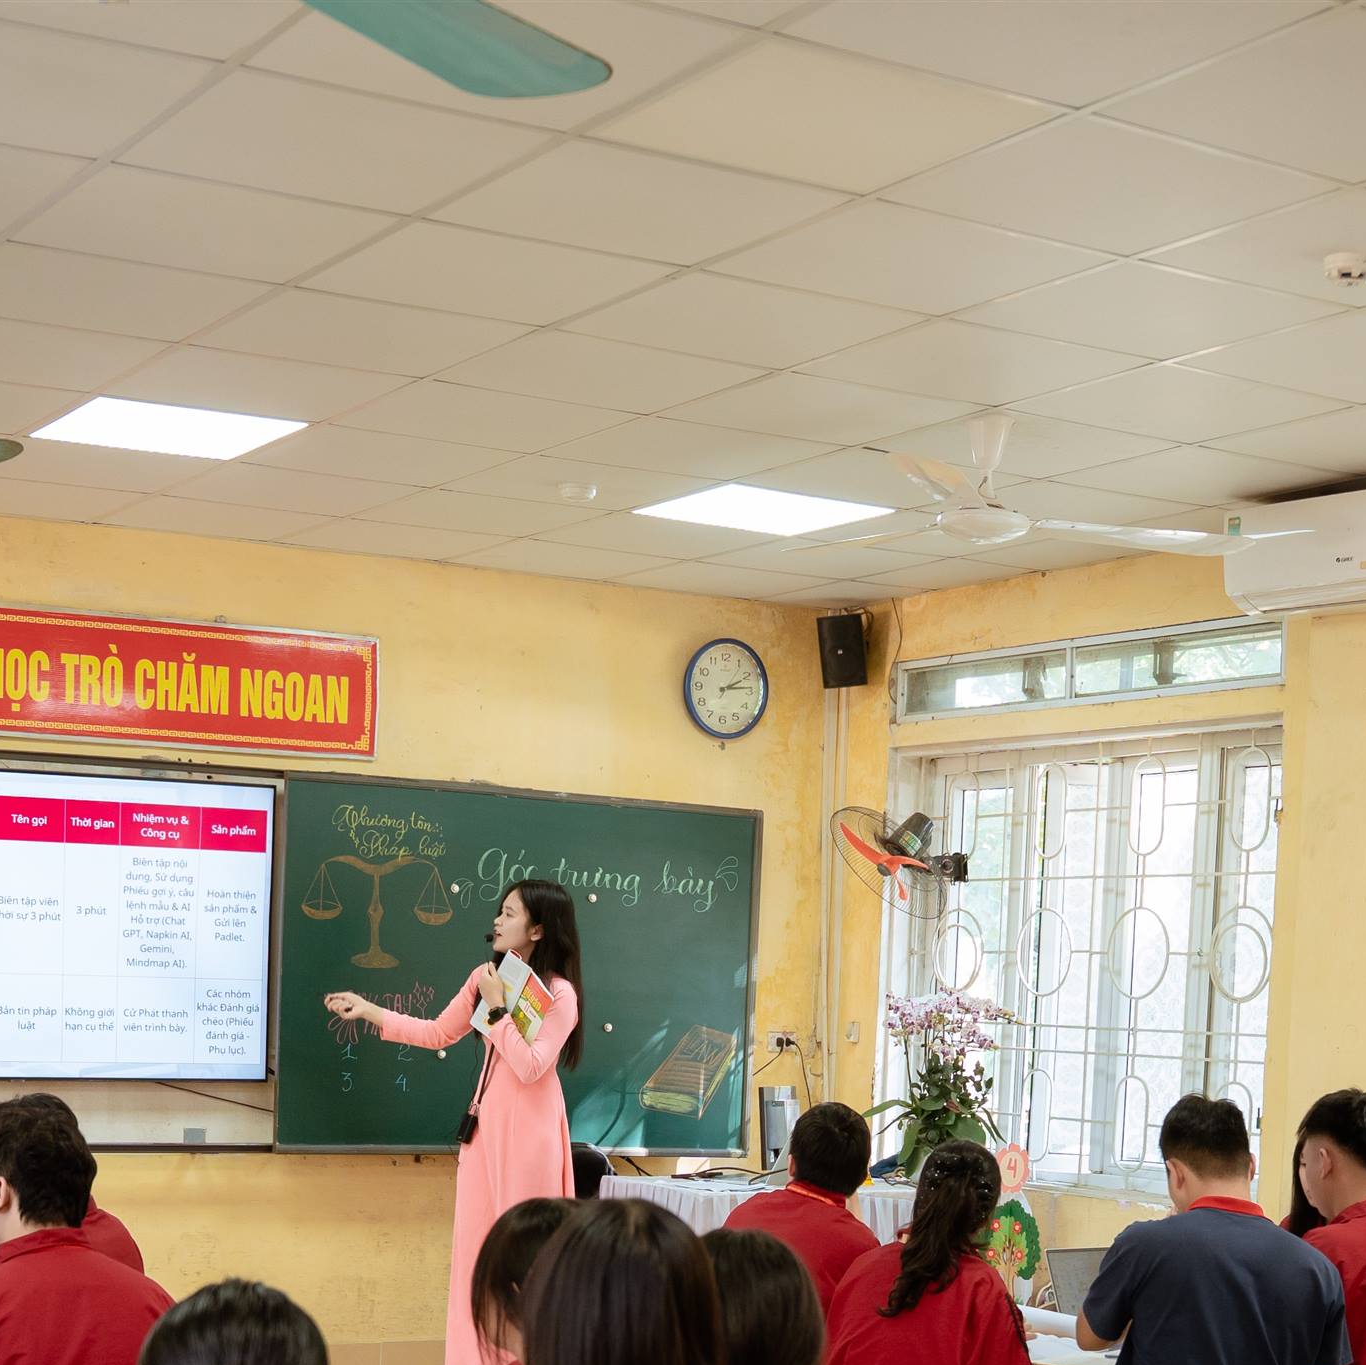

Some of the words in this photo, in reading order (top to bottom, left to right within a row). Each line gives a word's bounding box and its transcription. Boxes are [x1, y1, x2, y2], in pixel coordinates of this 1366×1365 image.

[710, 656, 717, 665] 11
[721, 653, 731, 662] 12
[737, 659, 741, 668] 1
[699, 668, 709, 676] 10
[742, 672, 751, 680] 2
[61, 643, 124, 708] TRÒ
[135, 652, 230, 715] CHĂM
[240, 667, 349, 725] NGOAN
[695, 682, 703, 691] 9
[698, 697, 706, 706] 8
[740, 702, 748, 710] 4
[707, 710, 714, 719] 7
[719, 715, 727, 724] 6
[11, 814, 29, 824] Tên
[32, 816, 47, 826] gọi
[70, 817, 92, 827] Thời
[94, 819, 115, 830] gian
[133, 813, 164, 824] Nhiệm
[166, 816, 179, 825] vụ
[181, 816, 189, 825] &
[141, 828, 166, 840] Công
[168, 831, 180, 840] cụ
[211, 825, 228, 834] Sản
[230, 825, 256, 836] phẩm
[419, 835, 446, 860] luật
[550, 857, 642, 907] trưng
[76, 906, 82, 914] 3
[84, 906, 106, 917] phút
[171, 903, 179, 911] &
[181, 903, 190, 912] AI
[250, 906, 257, 914] &
[31, 912, 37, 920] 3
[162, 916, 186, 927] (Chat
[146, 930, 178, 942] Napkin
[215, 932, 245, 942] Padlet.
[140, 944, 175, 954] Gemini,
[126, 958, 170, 969] Mindmap
[207, 989, 222, 998] Các
[32, 1008, 58, 1018] pháp
[65, 1008, 95, 1019] Không
[161, 1009, 189, 1018] thanh
[341, 1043, 357, 1060] 1
[341, 1072, 353, 1092] 3
[1006, 1157, 1017, 1178] 4
